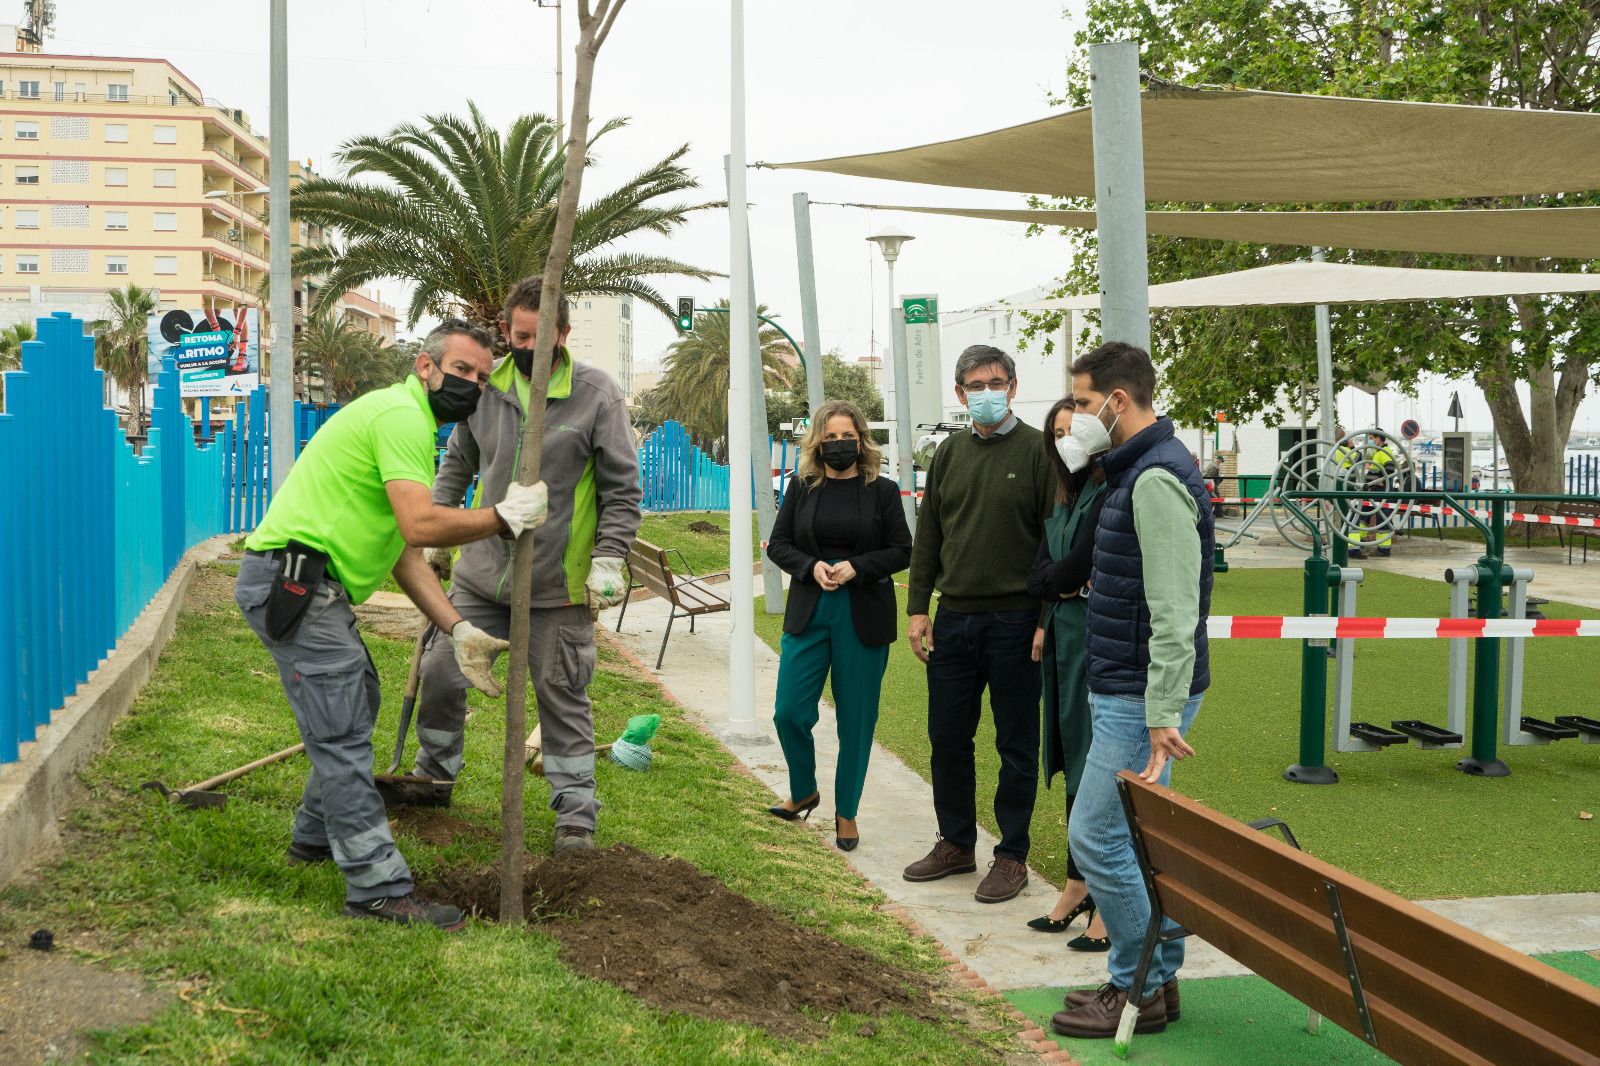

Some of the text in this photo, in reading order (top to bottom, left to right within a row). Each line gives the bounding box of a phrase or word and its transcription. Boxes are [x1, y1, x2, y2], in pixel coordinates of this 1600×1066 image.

[184, 334, 224, 344] RETOMA
[186, 346, 225, 359] RITMO
[914, 329, 924, 385] Puerto de Adra
